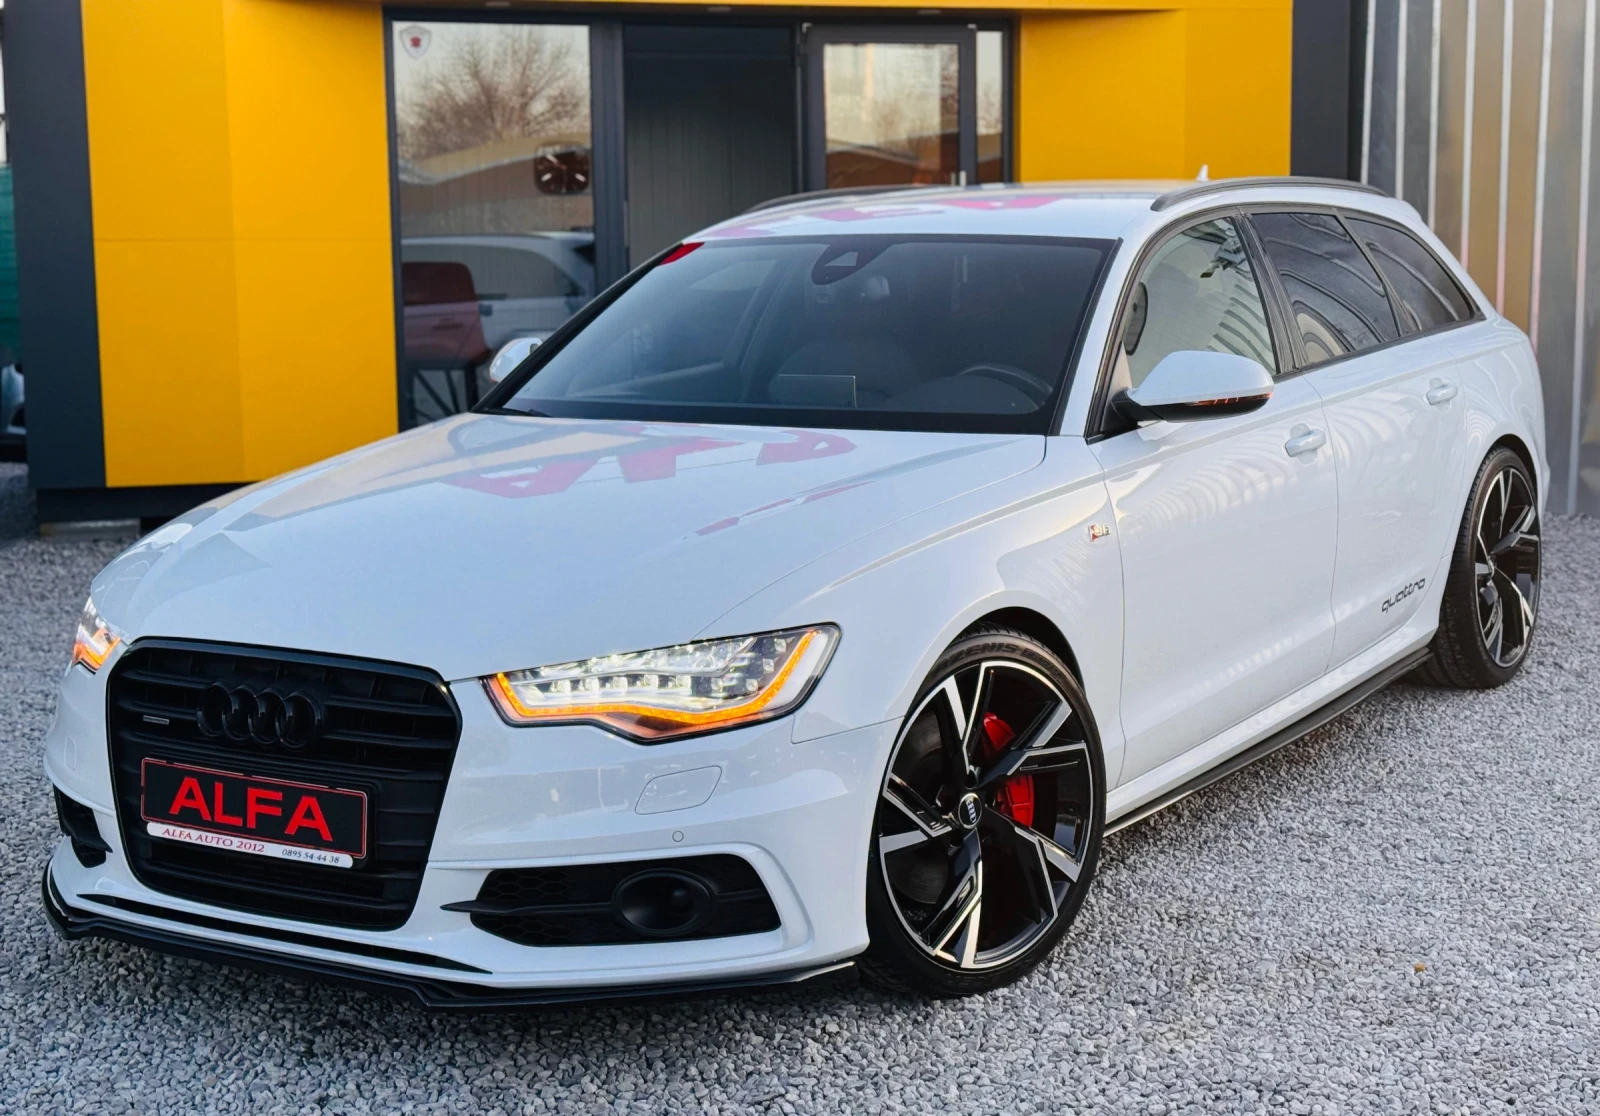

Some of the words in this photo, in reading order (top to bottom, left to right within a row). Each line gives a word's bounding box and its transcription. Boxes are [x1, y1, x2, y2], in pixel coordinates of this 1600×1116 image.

[1381, 577, 1426, 614] quattro
[169, 776, 333, 842] ALFA
[162, 828, 192, 840] ALFA
[195, 834, 233, 847] AUTO
[236, 840, 265, 852] 2012
[281, 848, 302, 858] 0895
[303, 852, 314, 860] 54
[316, 854, 327, 862] 44
[328, 855, 340, 863] 38
